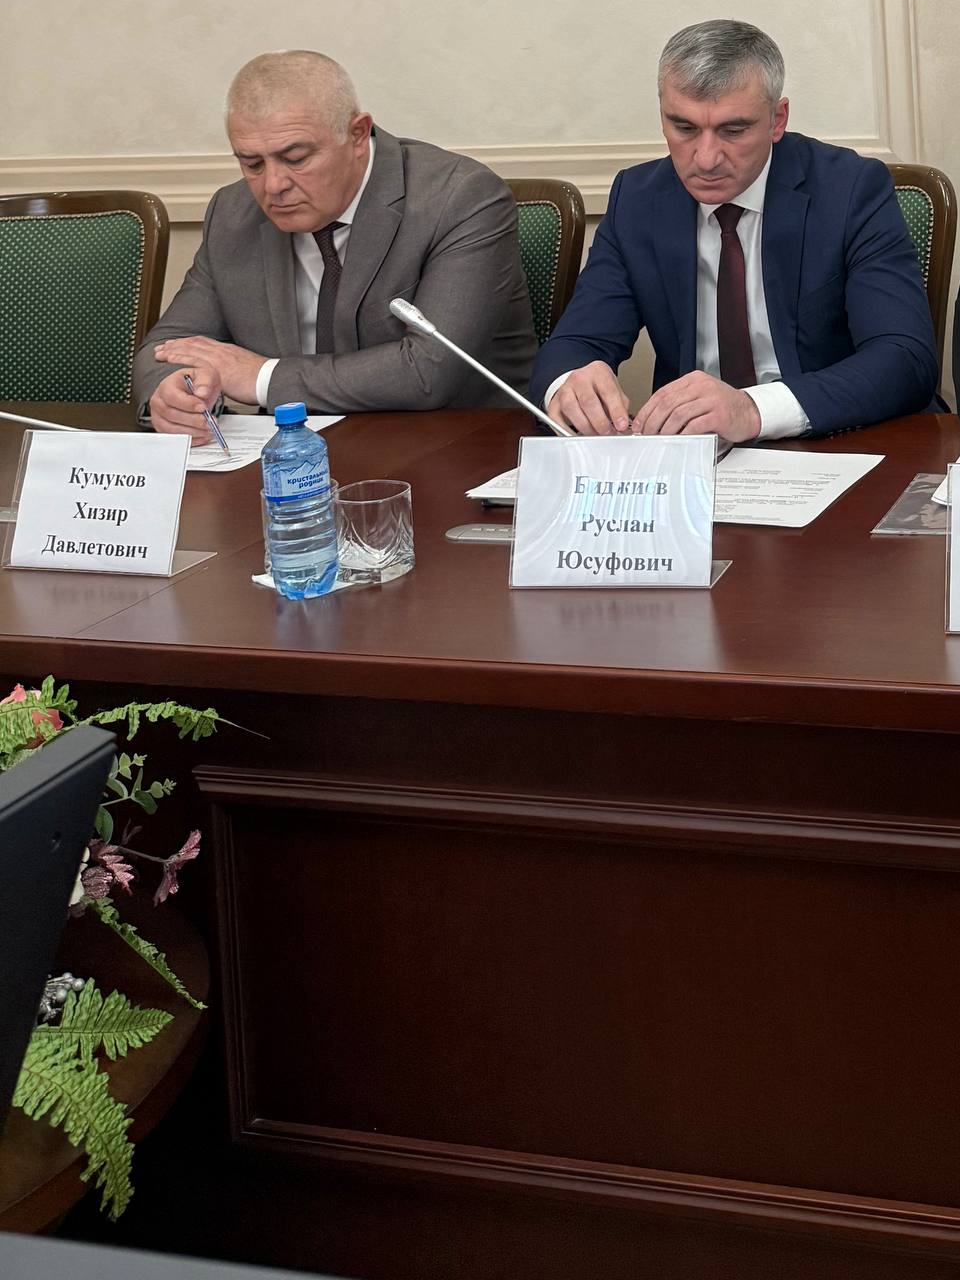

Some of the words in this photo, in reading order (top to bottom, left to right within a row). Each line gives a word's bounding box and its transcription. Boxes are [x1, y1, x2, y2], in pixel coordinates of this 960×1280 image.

[68, 467, 146, 489] Кумуков
[72, 501, 129, 526] Хизир
[579, 513, 655, 537] Руслан
[41, 534, 148, 559] Давлетович
[556, 549, 674, 576] Юсуфович
